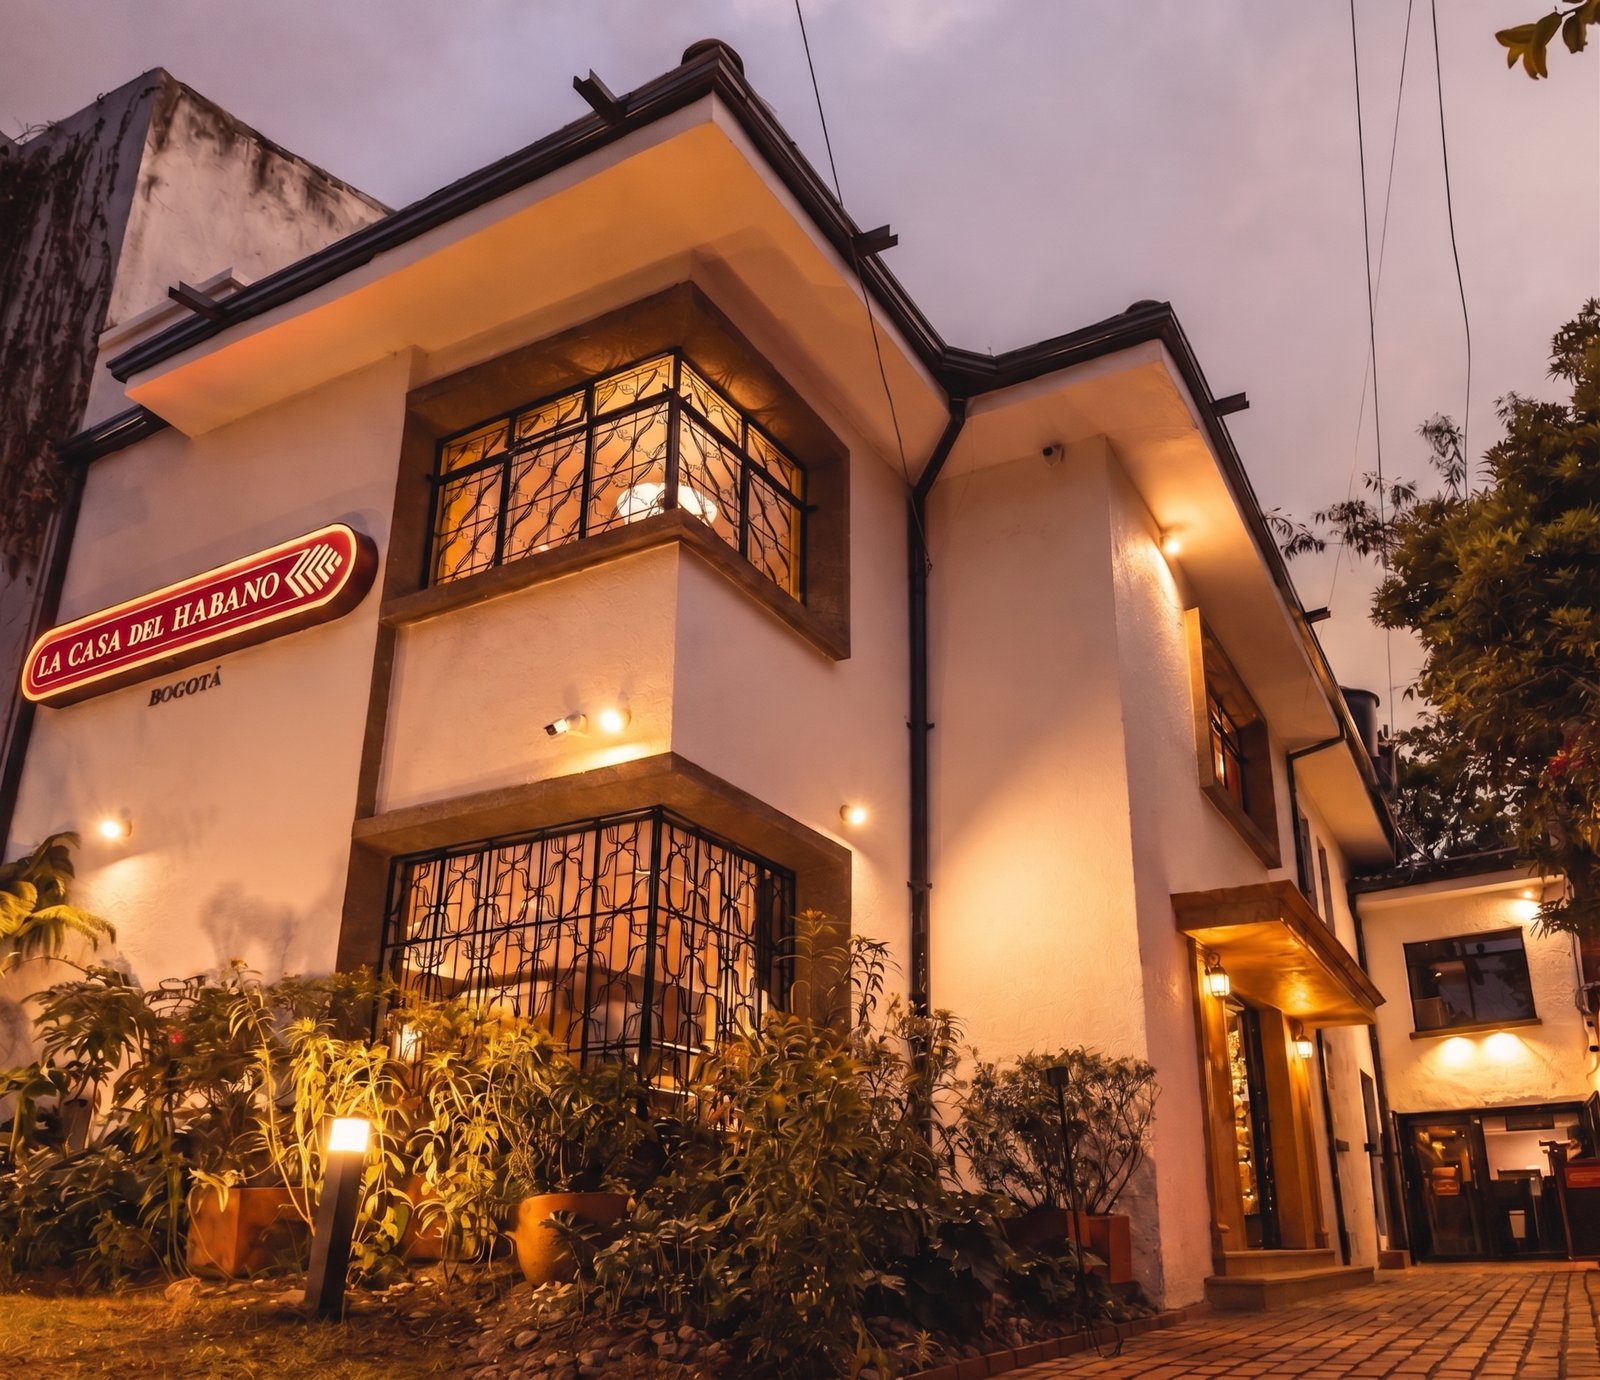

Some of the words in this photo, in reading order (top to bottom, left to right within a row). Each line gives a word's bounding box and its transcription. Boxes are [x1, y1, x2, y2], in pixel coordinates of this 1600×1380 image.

[37, 651, 61, 678] LA
[68, 629, 121, 667] CASA
[127, 615, 164, 647] DEL
[171, 572, 280, 631] HABANO
[148, 665, 222, 707] BOGOTÁ
